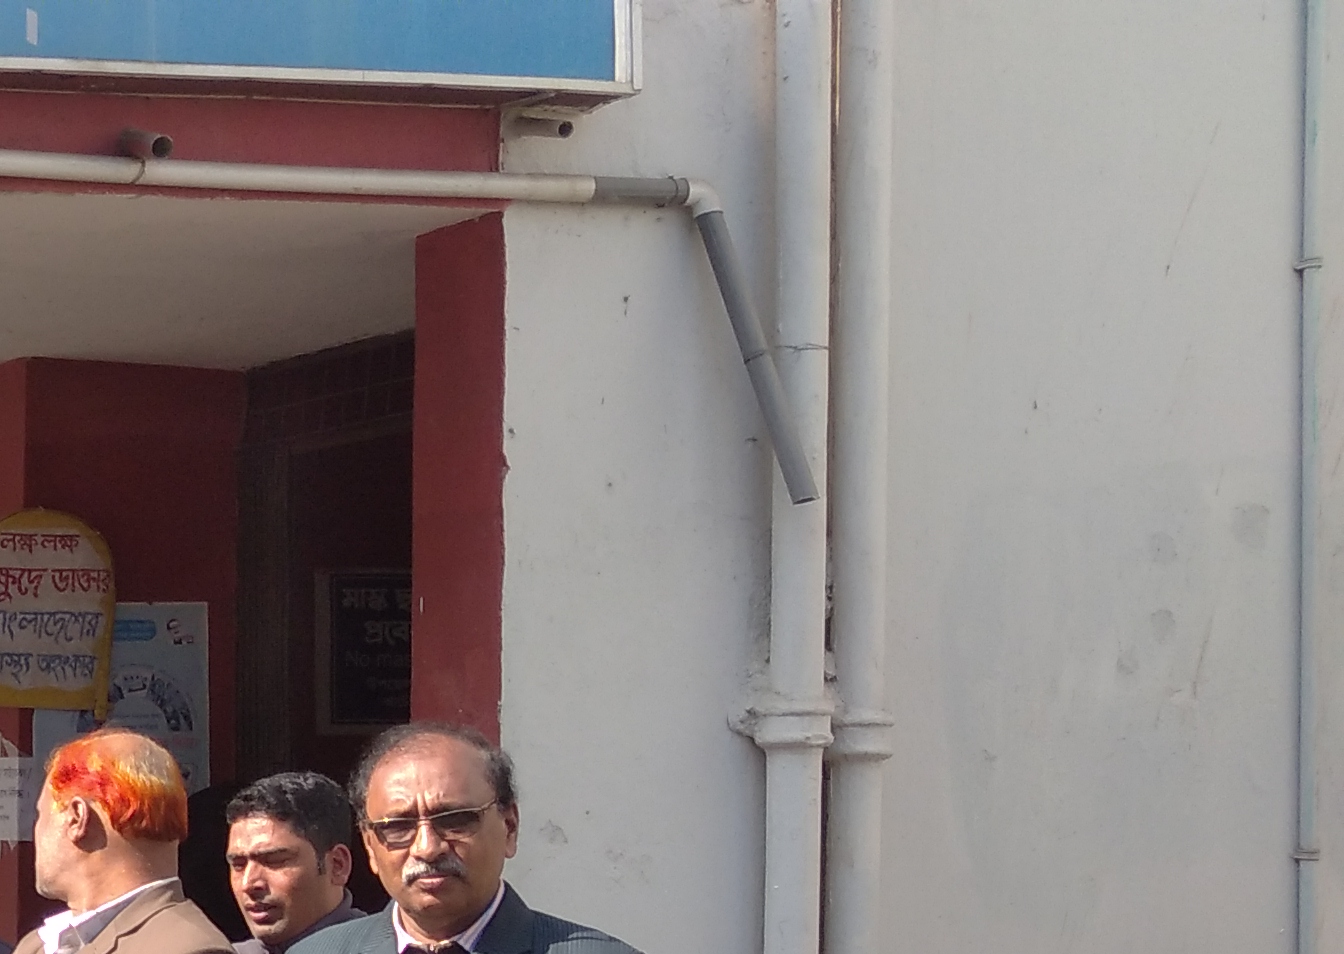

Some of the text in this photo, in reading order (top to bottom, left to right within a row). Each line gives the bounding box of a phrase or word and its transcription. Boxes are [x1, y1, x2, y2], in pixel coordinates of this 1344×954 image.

[0, 532, 81, 555] লক্ষ লক্ষ
[50, 568, 112, 594] ডাক্তার
[37, 654, 99, 682] অহংকার
